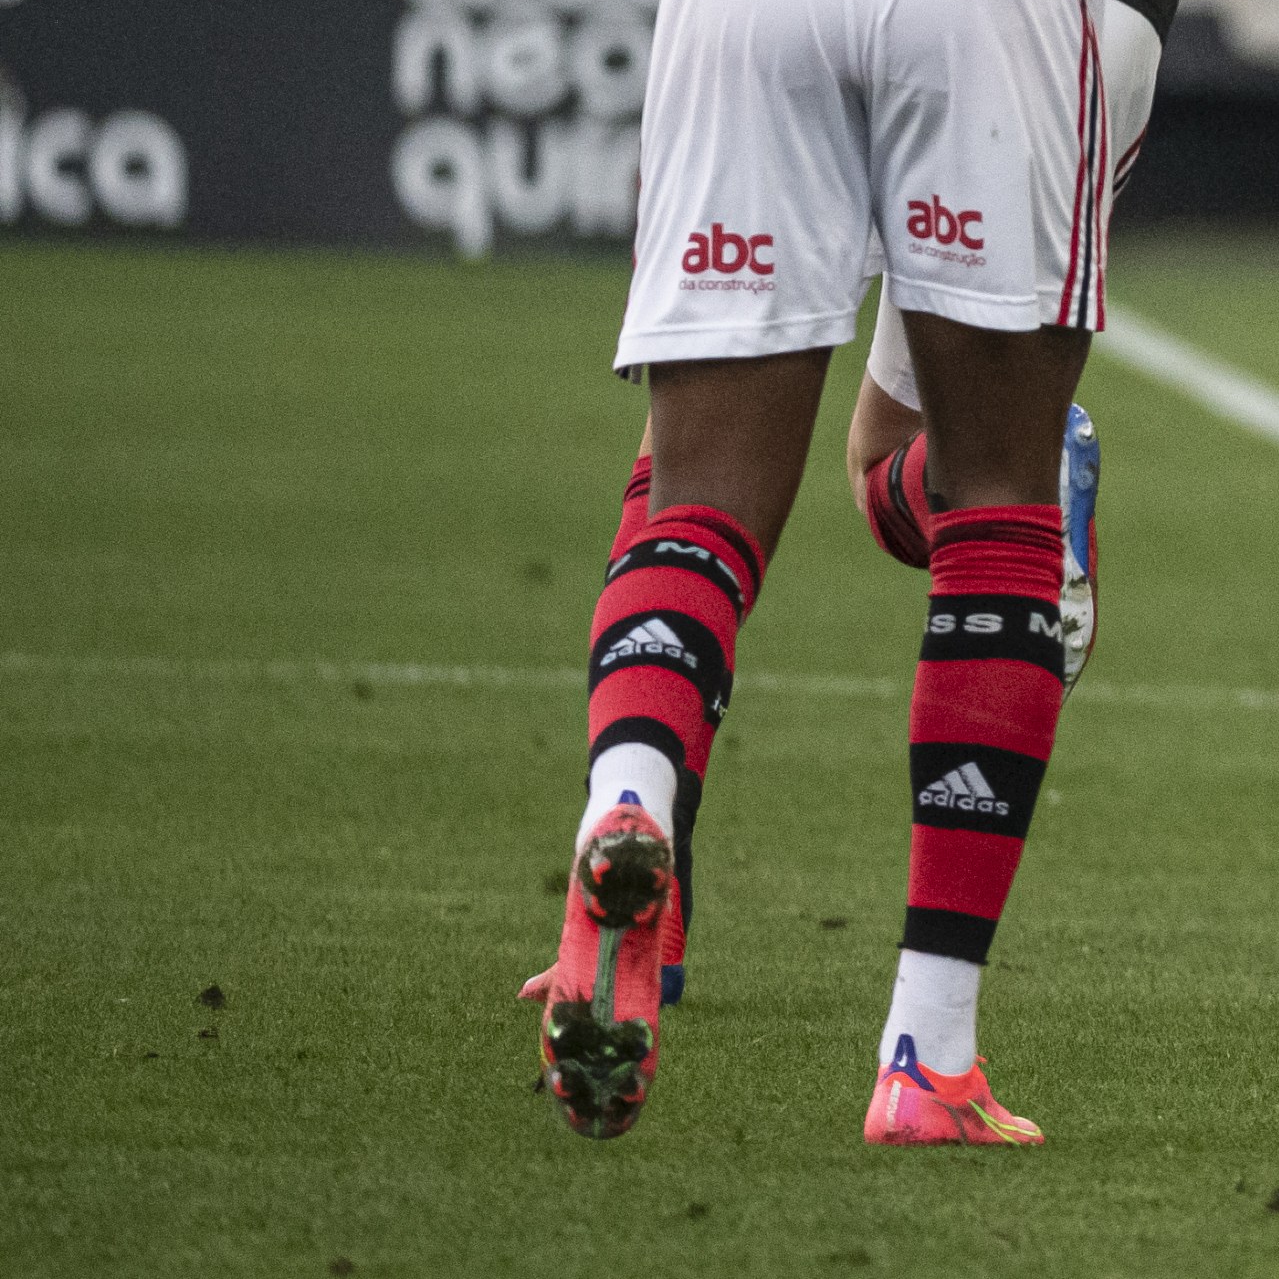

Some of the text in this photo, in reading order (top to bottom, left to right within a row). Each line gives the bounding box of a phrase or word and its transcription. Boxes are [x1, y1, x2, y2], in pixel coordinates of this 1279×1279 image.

[907, 194, 984, 250] abc
[681, 223, 775, 275] abc
[679, 278, 776, 295] da construção
[599, 643, 699, 669] adidas
[918, 789, 1010, 816] adidas
